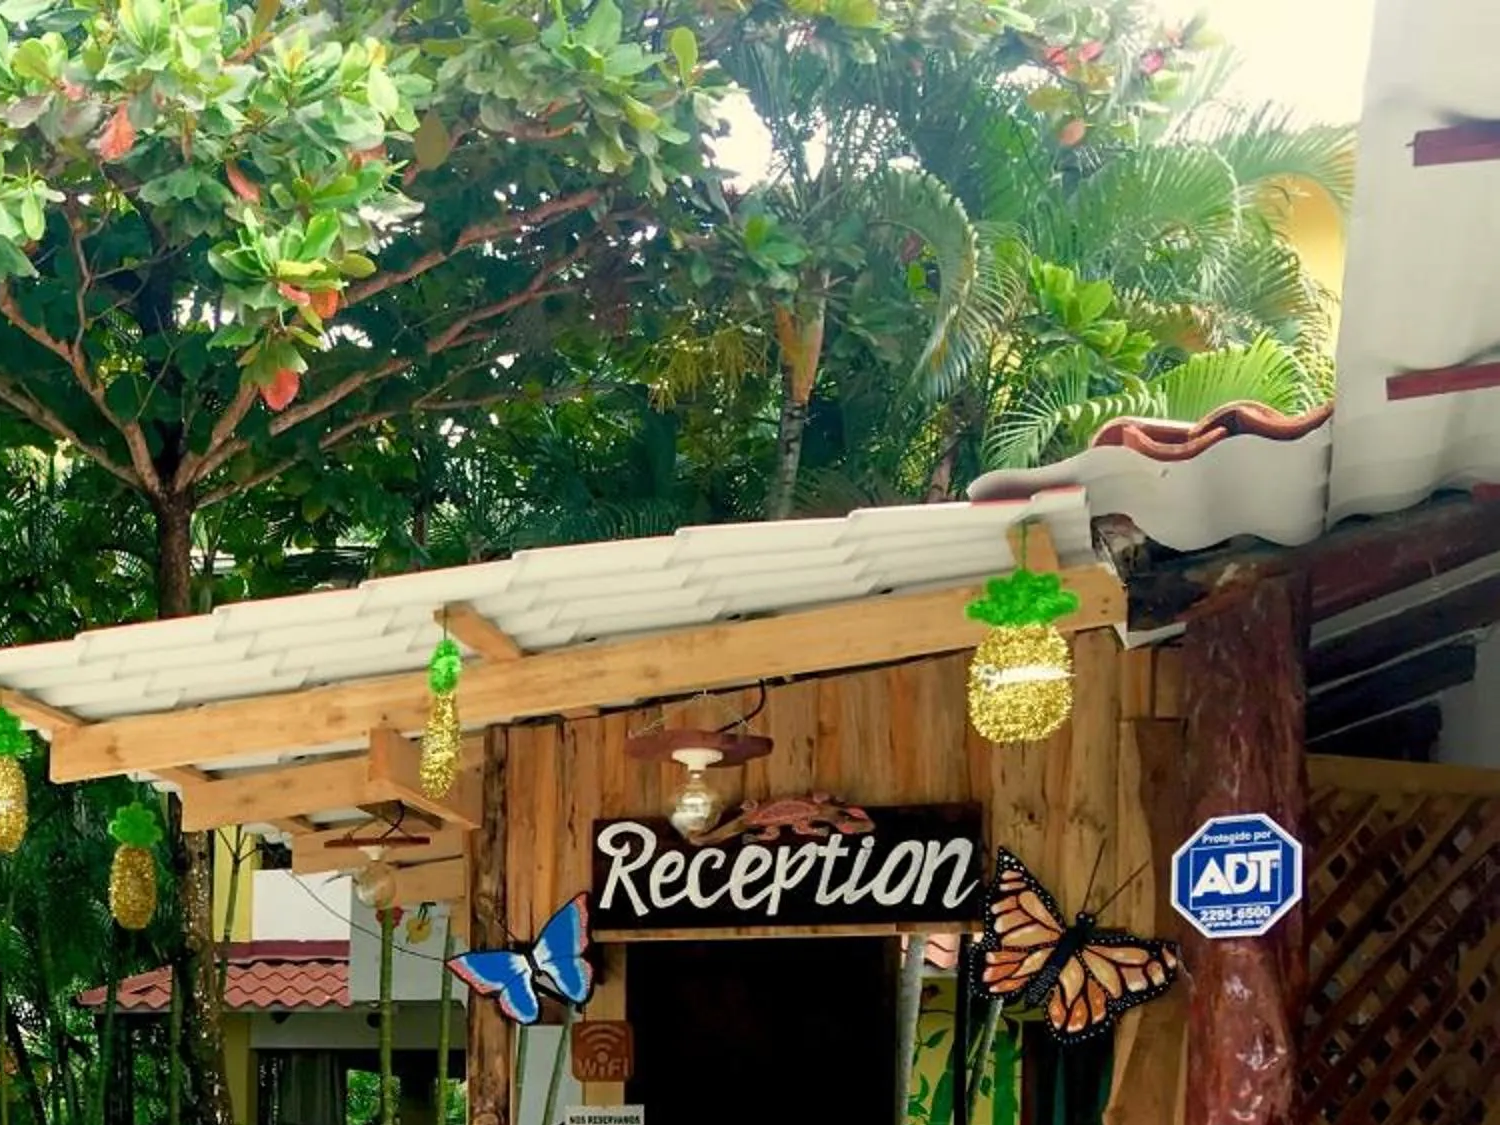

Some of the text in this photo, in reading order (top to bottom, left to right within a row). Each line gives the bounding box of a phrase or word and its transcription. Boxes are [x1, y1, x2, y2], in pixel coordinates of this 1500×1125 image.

[598, 821, 980, 917] Reception
[1191, 850, 1281, 897] ADT
[569, 1115, 586, 1125] NOS
